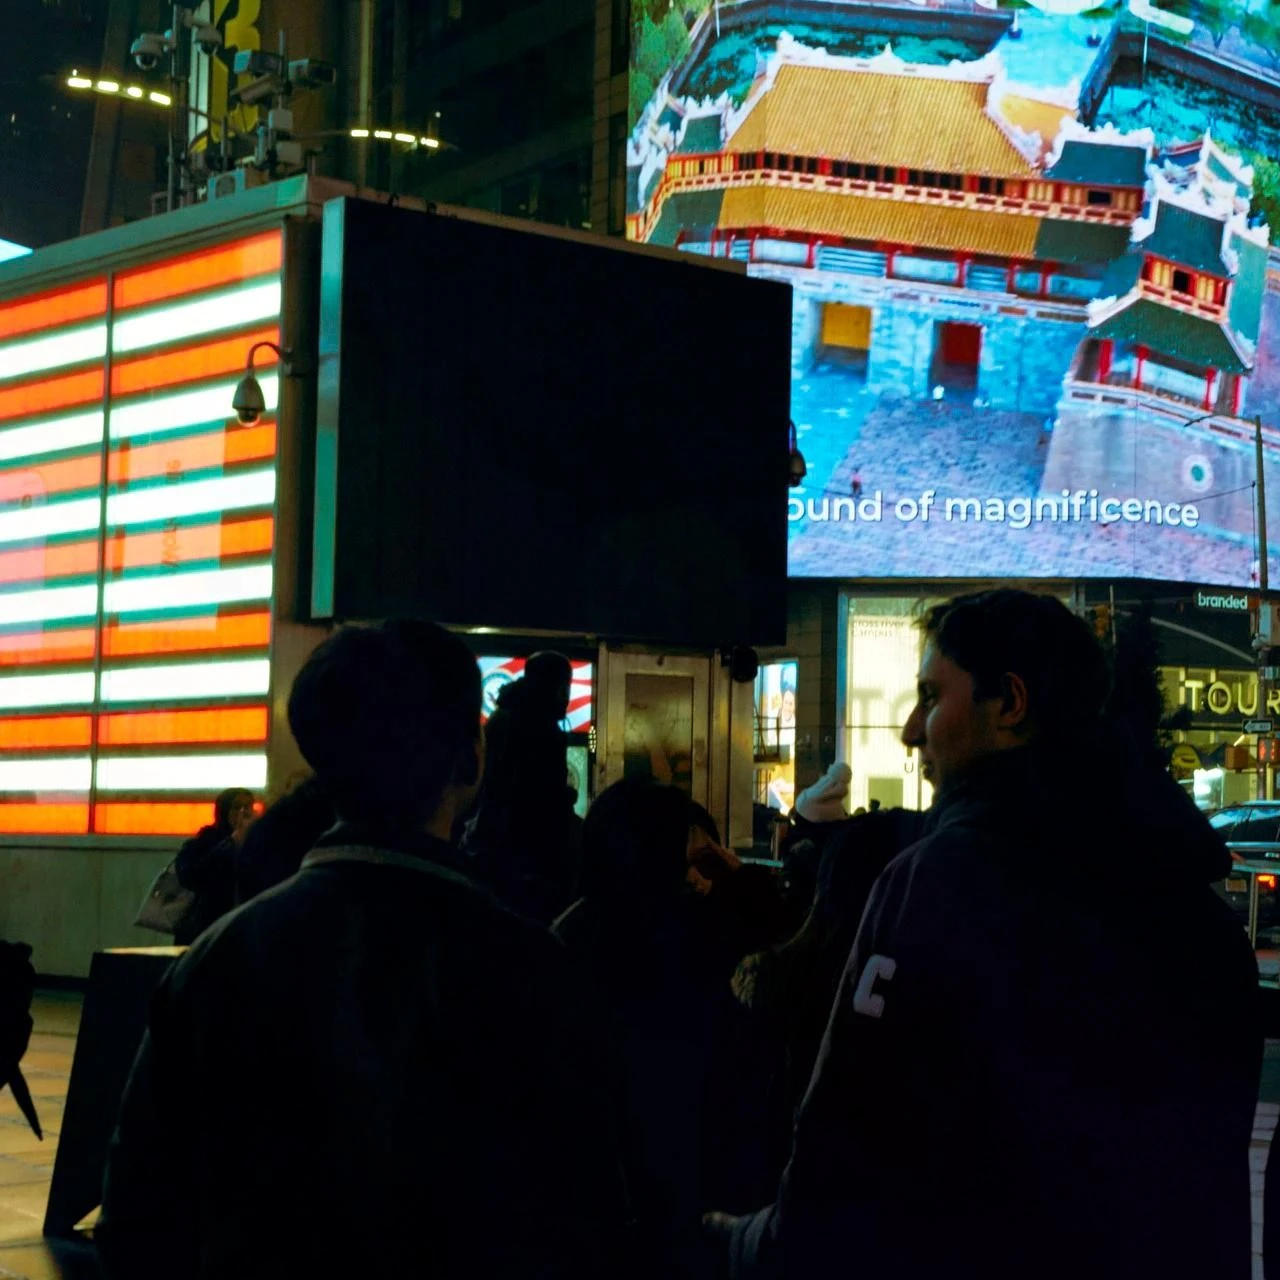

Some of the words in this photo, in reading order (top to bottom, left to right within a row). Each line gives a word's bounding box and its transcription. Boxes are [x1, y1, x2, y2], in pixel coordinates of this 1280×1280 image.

[894, 490, 936, 522] of
[944, 489, 1200, 529] magnificence
[1197, 591, 1248, 610] branded
[852, 953, 898, 1018] C
